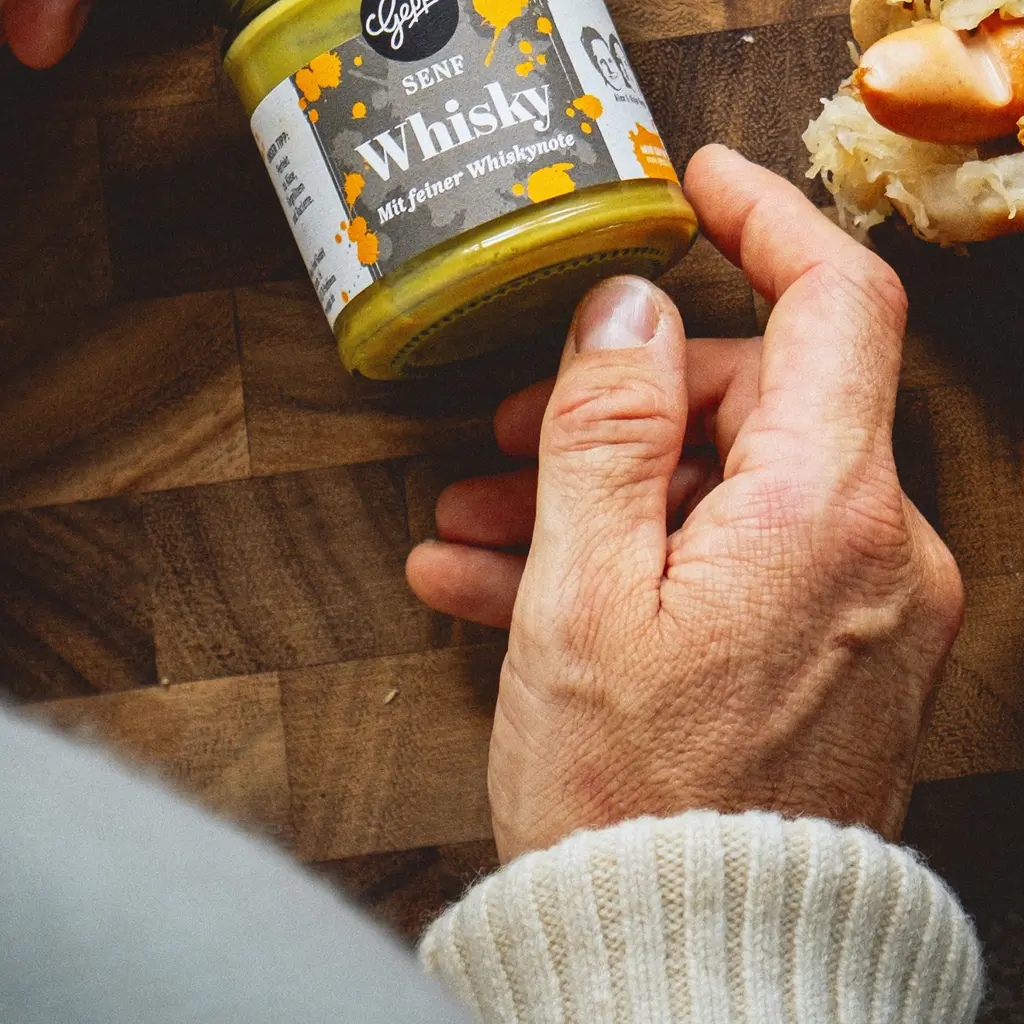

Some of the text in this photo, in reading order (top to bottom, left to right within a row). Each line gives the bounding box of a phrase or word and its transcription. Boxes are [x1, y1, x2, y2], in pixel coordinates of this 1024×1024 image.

[402, 54, 465, 96] SENF
[353, 81, 551, 183] Whisky
[376, 133, 576, 225] Mit feiner Whiskynote
